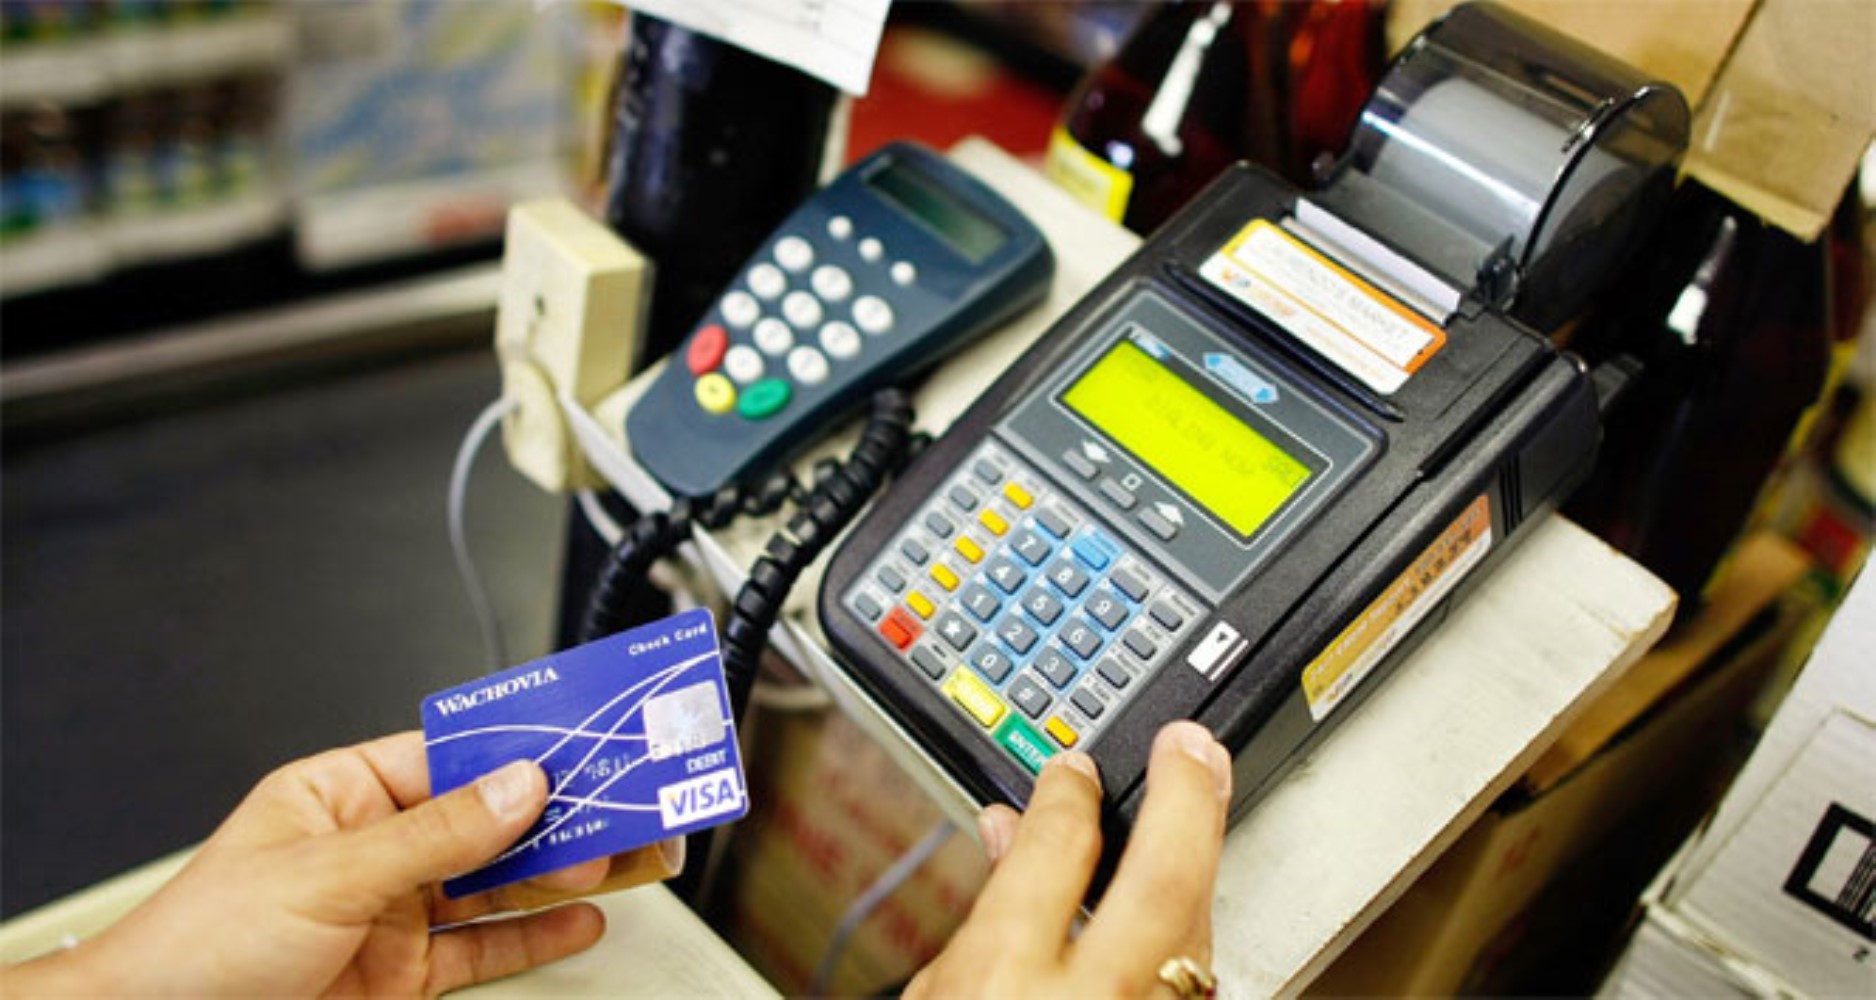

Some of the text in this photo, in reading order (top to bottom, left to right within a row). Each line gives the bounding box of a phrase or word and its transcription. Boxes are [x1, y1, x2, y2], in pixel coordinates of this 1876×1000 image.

[1020, 535, 1037, 550] 7
[995, 566, 1011, 581] 4
[1057, 567, 1075, 582] 8
[971, 593, 984, 608] 1
[1032, 595, 1048, 610] 5
[1099, 599, 1112, 614] 9
[628, 622, 708, 656] Check Card
[1006, 624, 1023, 641] 2
[1071, 627, 1085, 644] 6
[981, 654, 997, 669] 0
[1044, 656, 1059, 673] 3
[434, 667, 560, 717] WACHOVIA
[686, 747, 727, 774] DEBIT
[670, 777, 736, 817] VISA
